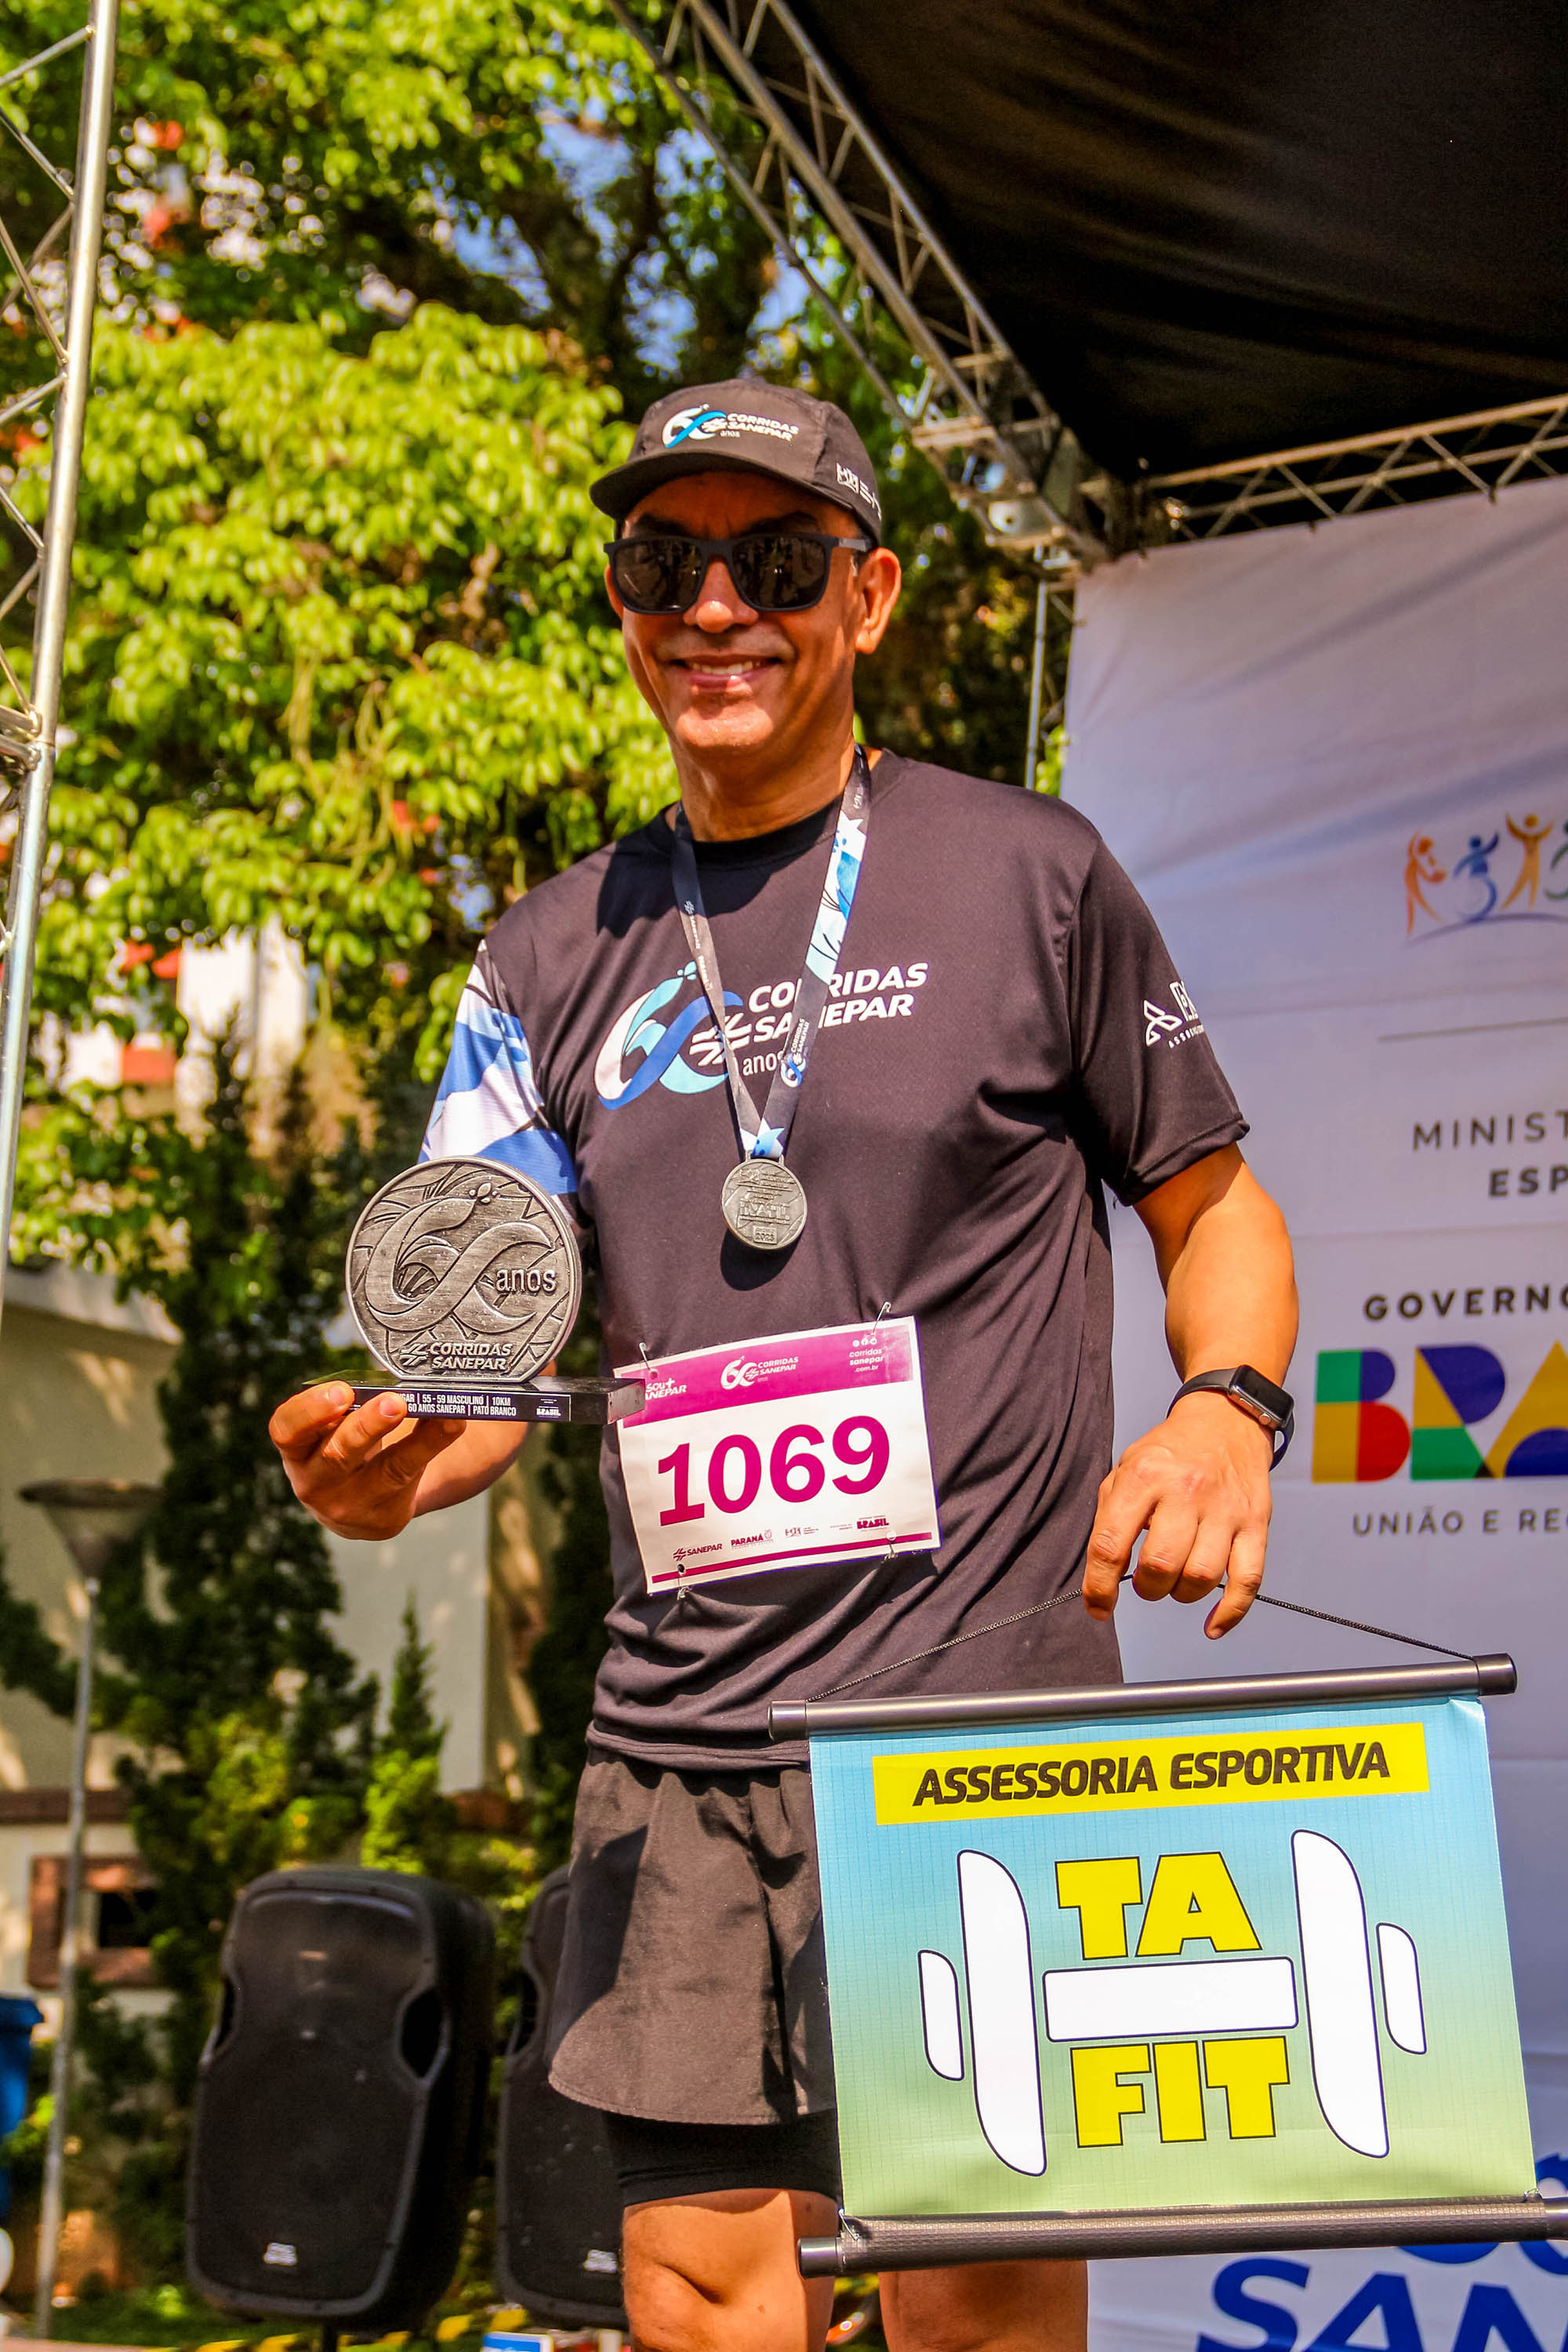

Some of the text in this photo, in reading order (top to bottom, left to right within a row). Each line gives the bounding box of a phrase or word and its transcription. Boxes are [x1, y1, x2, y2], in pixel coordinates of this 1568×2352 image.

[727, 412, 800, 435] CORRIDAS
[727, 421, 793, 441] SANEPAR
[748, 963, 929, 1013] CORIDAS
[790, 1018, 805, 1053] CORRIDAS
[1489, 1163, 1568, 1199] ESP
[495, 1269, 557, 1293] anos
[430, 1341, 513, 1356] CORRIDAS
[849, 1348, 883, 1358] corridas
[431, 1356, 507, 1370] SANEPAR
[757, 1356, 799, 1369] CORRIDAS
[759, 1364, 797, 1375] SANEPAR
[849, 1356, 884, 1366] sanepar
[422, 1395, 432, 1403] 55
[437, 1395, 446, 1403] 59
[447, 1395, 484, 1406] MASCULINO
[492, 1396, 511, 1406] 10KM
[645, 1385, 687, 1401] ANEPAR
[418, 1404, 436, 1413] ANOS
[436, 1404, 466, 1414] SANEPAR
[473, 1406, 489, 1415] PATO
[490, 1406, 517, 1417] BRANCO
[658, 1415, 890, 1526] 1069
[856, 1518, 890, 1530] BRASIL
[1352, 1505, 1568, 1537] UNIÃO E RE
[687, 1543, 723, 1556] SANEPAR
[912, 1740, 1392, 1806] ASSESSORIA ESPORTIVA
[1054, 1851, 1263, 1961] TA
[1069, 2035, 1290, 2148] FIT
